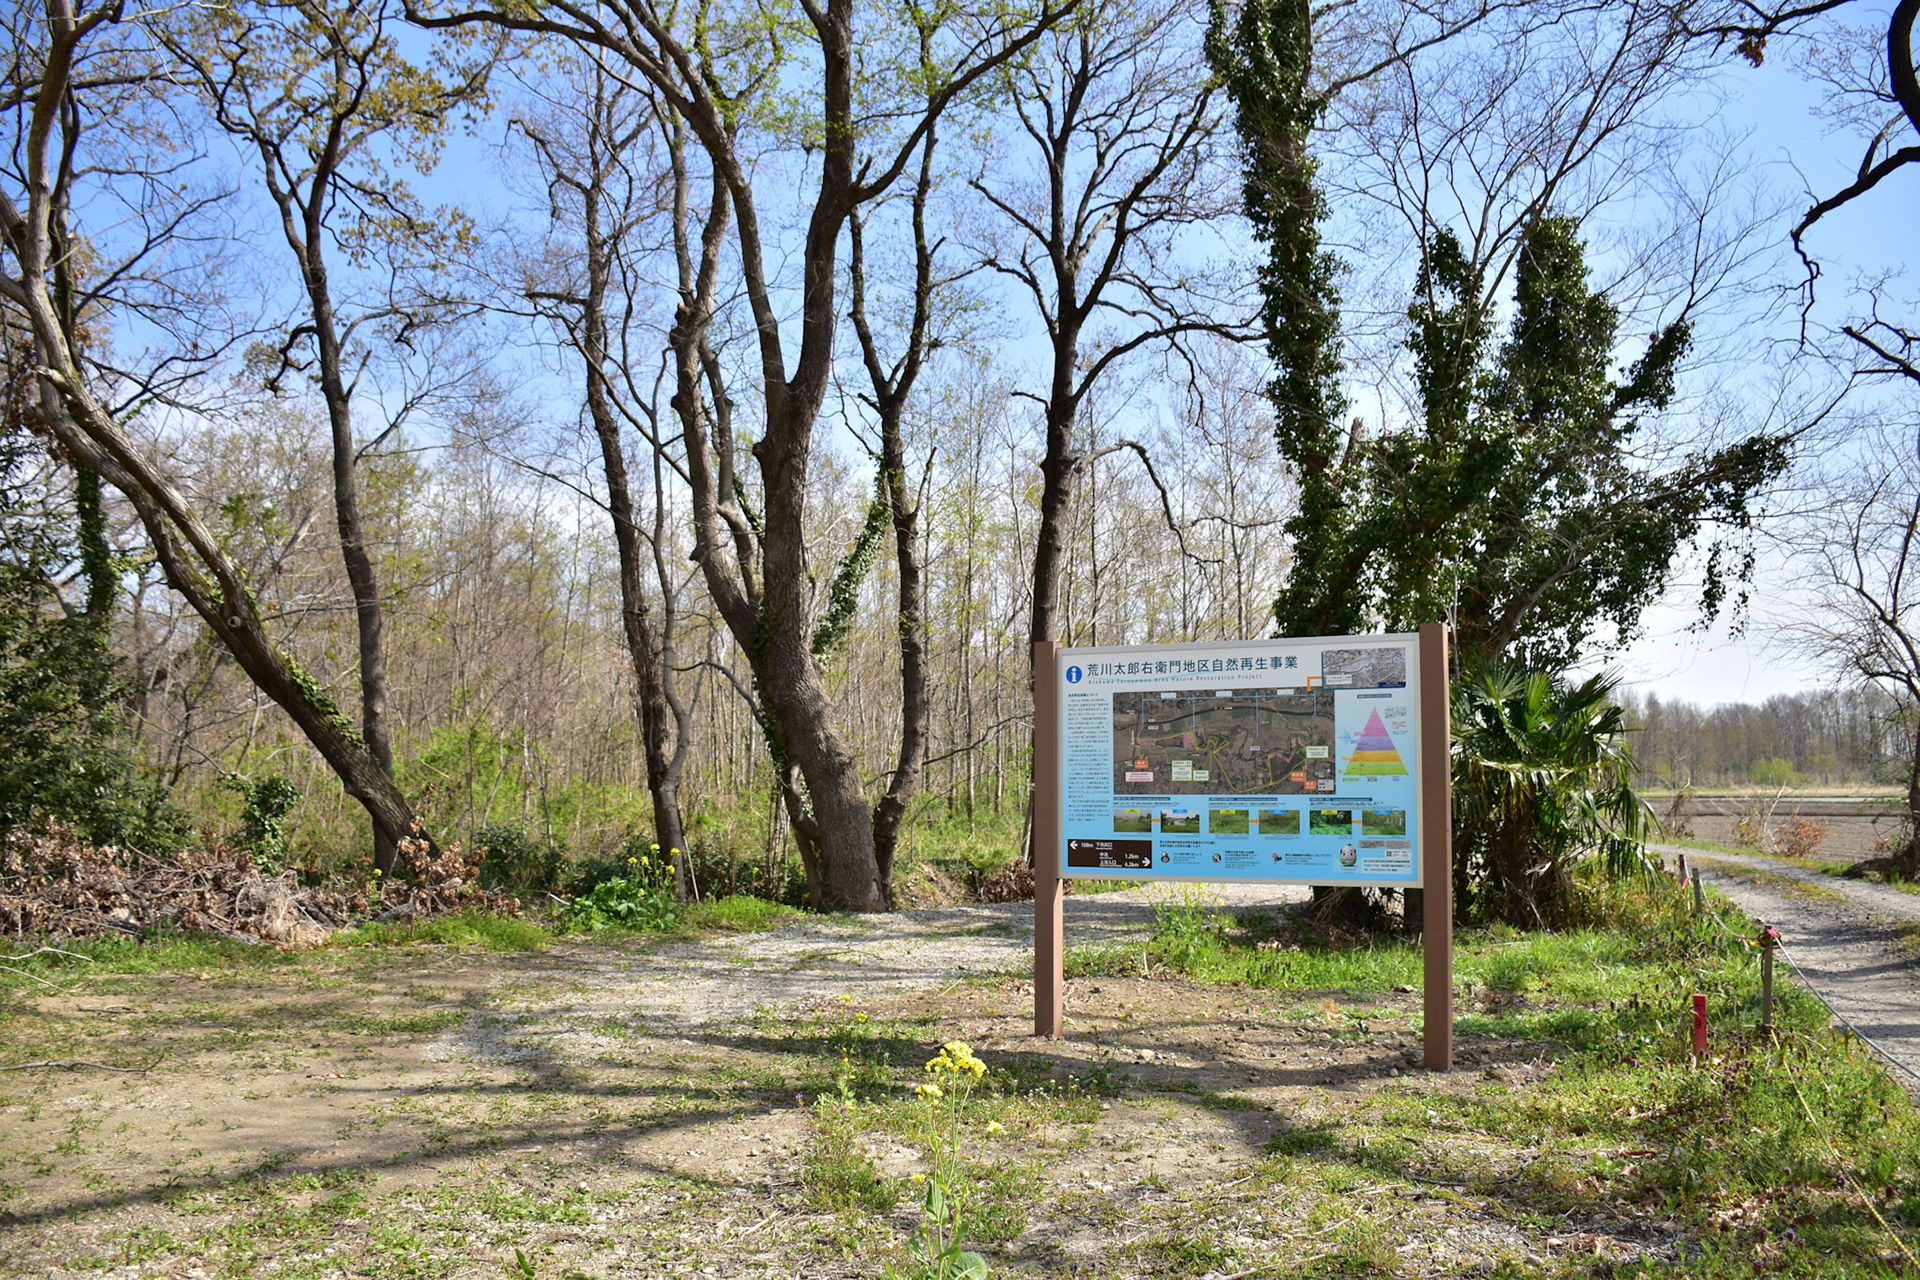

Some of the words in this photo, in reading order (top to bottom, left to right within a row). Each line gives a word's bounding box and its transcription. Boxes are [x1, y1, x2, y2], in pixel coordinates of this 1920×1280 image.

[1087, 655, 1298, 677] 荒川太郎右衛門地区自然再生事業
